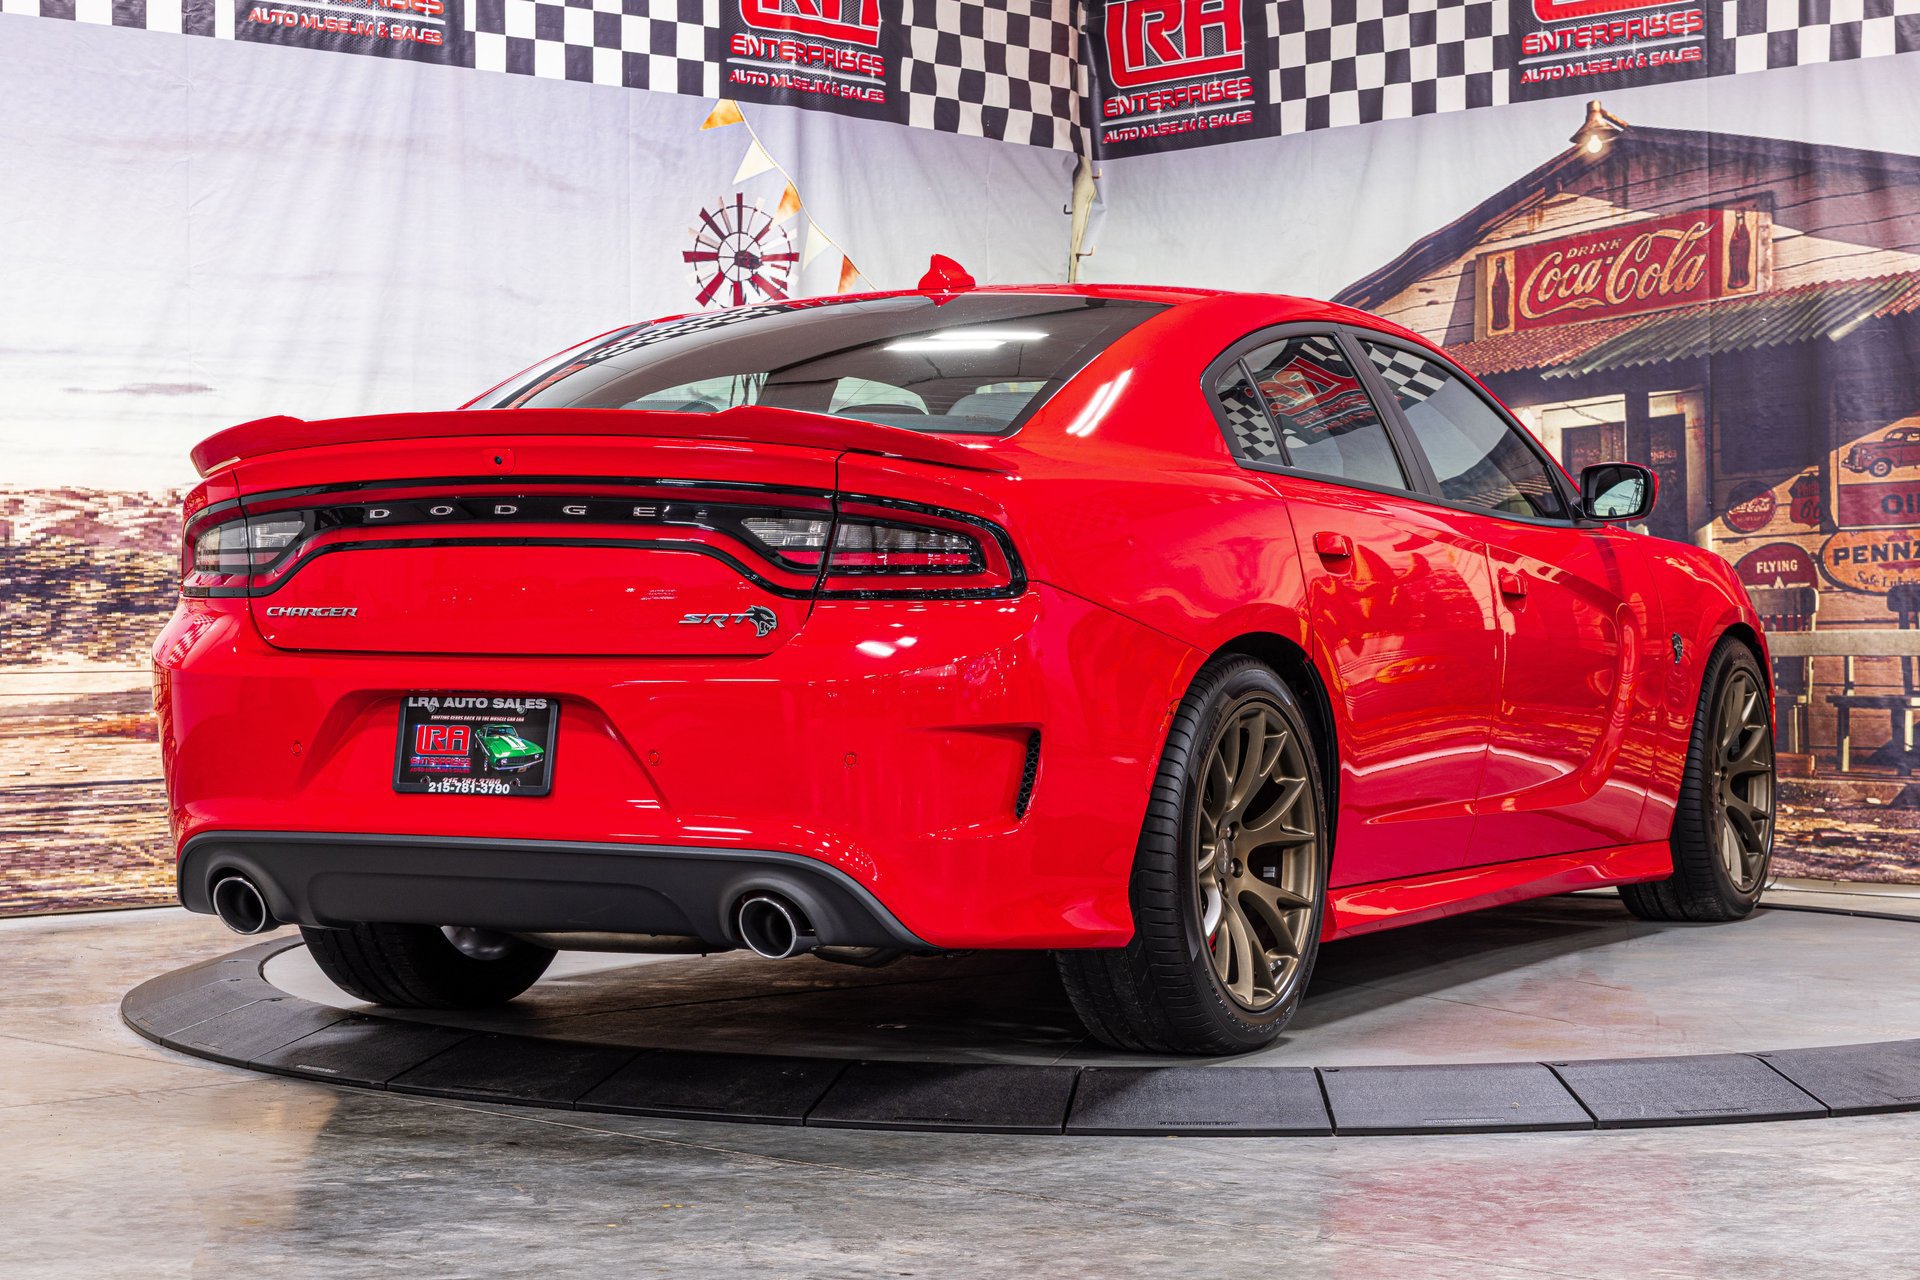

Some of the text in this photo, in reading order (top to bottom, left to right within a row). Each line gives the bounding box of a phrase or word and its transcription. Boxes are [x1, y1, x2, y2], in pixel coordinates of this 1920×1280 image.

[248, 7, 443, 45] AUTO MUSEUM & SALES
[1521, 8, 1704, 55] ENTERPRISES
[729, 33, 886, 77] ENTERPRISES
[1519, 46, 1703, 84] AUTO MUSEUM & SALES
[729, 69, 886, 104] AUTO MUSEUM & SALES
[1103, 77, 1253, 117] ENTERPRISES
[1102, 111, 1253, 144] AUTO MUSEUM & SALES
[1566, 238, 1622, 259] DRINK
[1519, 221, 1715, 319] Coca-Cola
[369, 505, 656, 519] DODGE
[1881, 493, 1920, 515] OI
[1756, 559, 1798, 574] FLYING
[266, 607, 358, 617] CHARGER
[678, 613, 755, 628] SRT
[408, 697, 547, 710] LRA AUTO SALES
[415, 725, 471, 756] LRA
[427, 781, 510, 794] 215-781-3790
